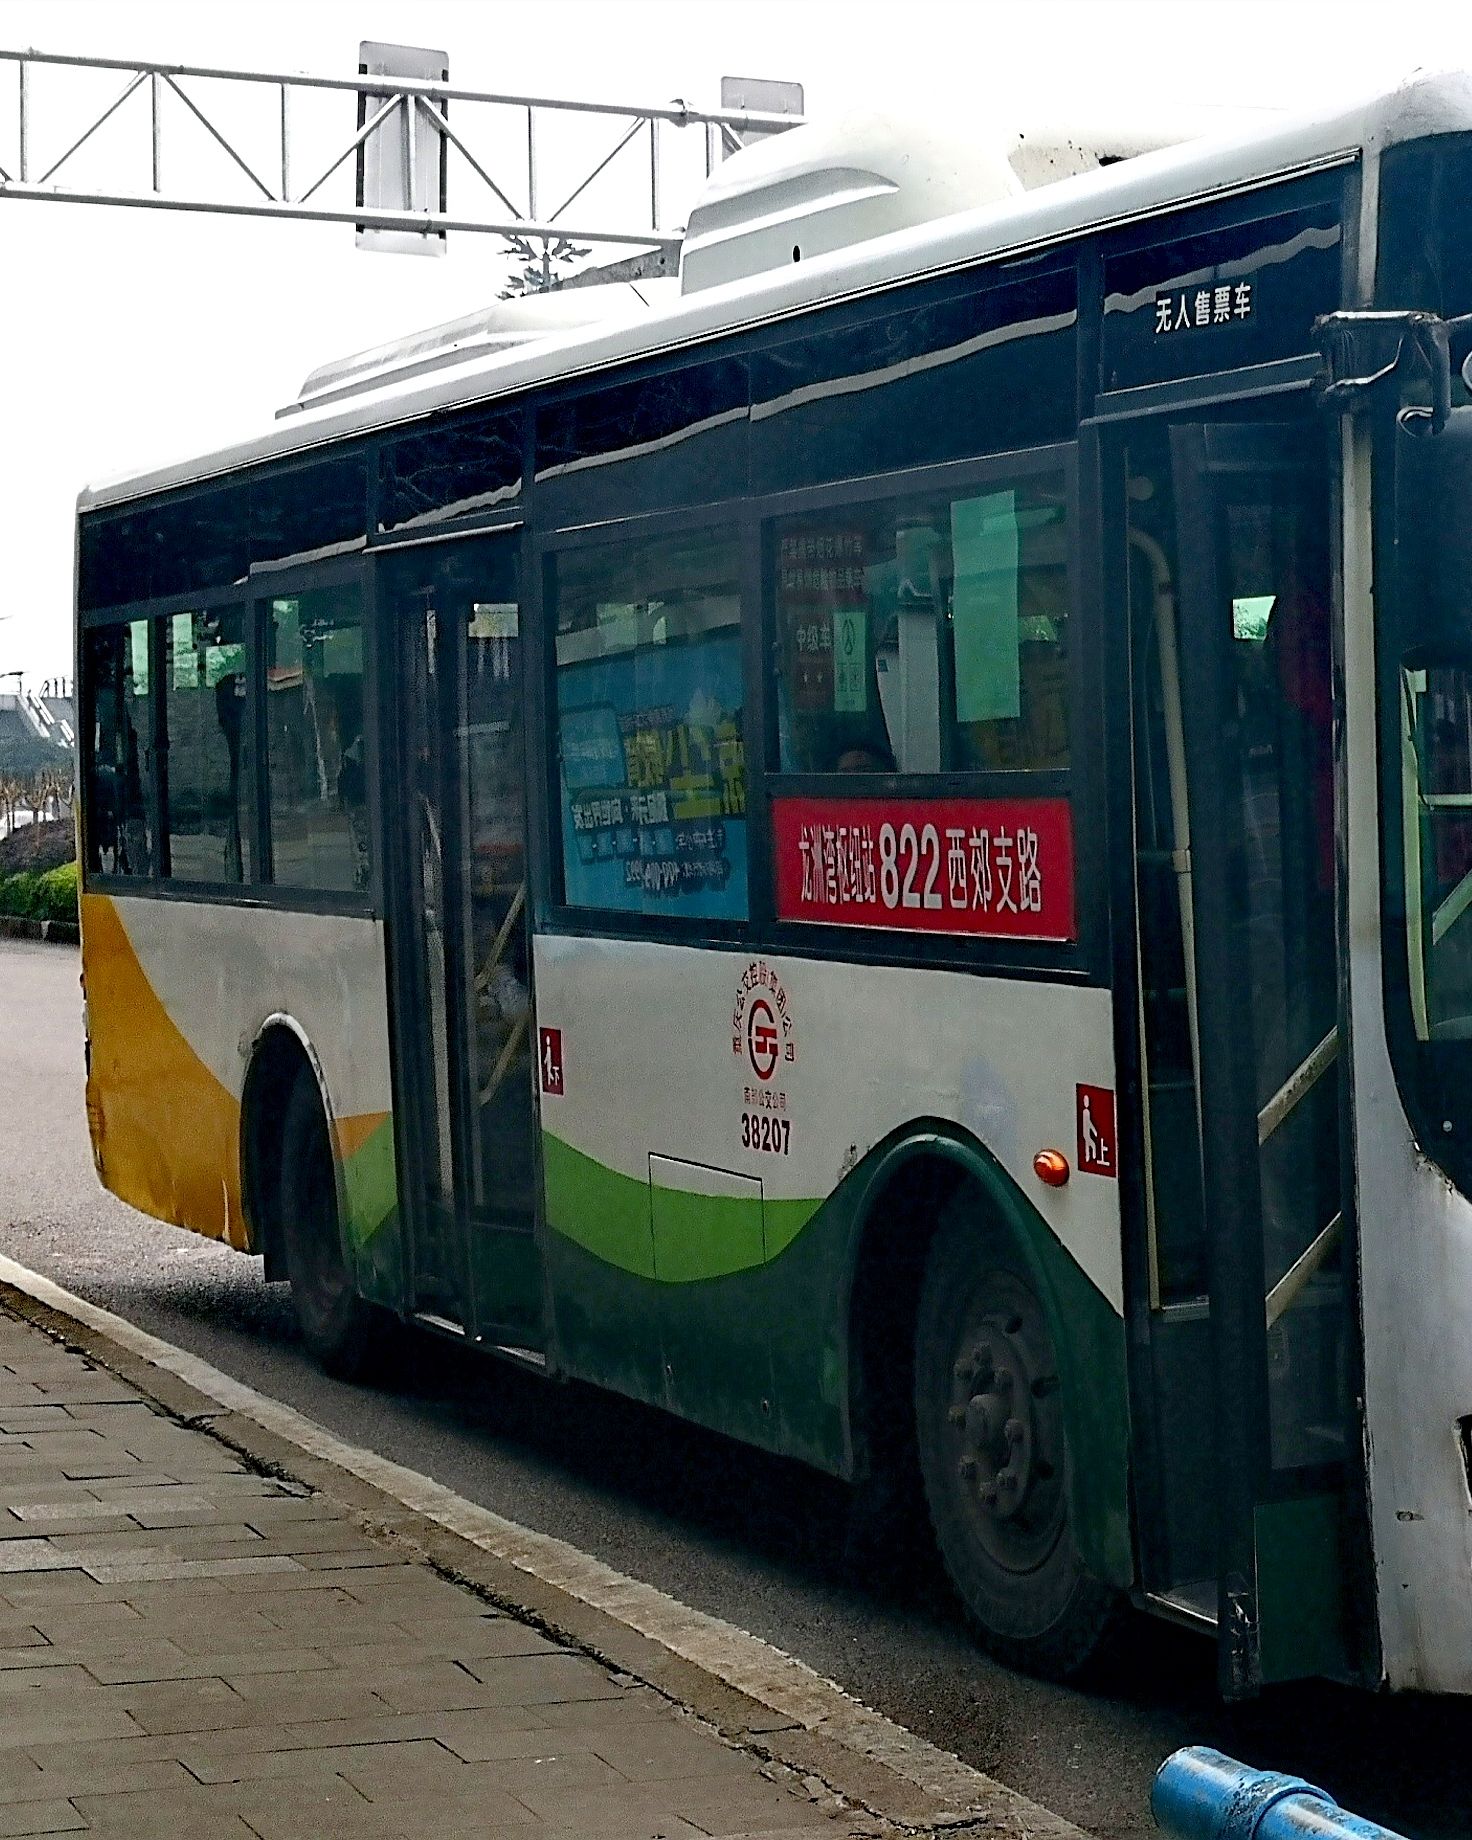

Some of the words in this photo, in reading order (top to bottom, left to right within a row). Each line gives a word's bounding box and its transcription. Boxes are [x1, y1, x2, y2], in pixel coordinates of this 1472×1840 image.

[1155, 281, 1251, 334] 无人售票车
[798, 822, 874, 903] 龙洲湾枢纽站
[879, 822, 943, 910] 822
[945, 826, 1042, 914] 西郊支路
[741, 1113, 790, 1155] 38207
